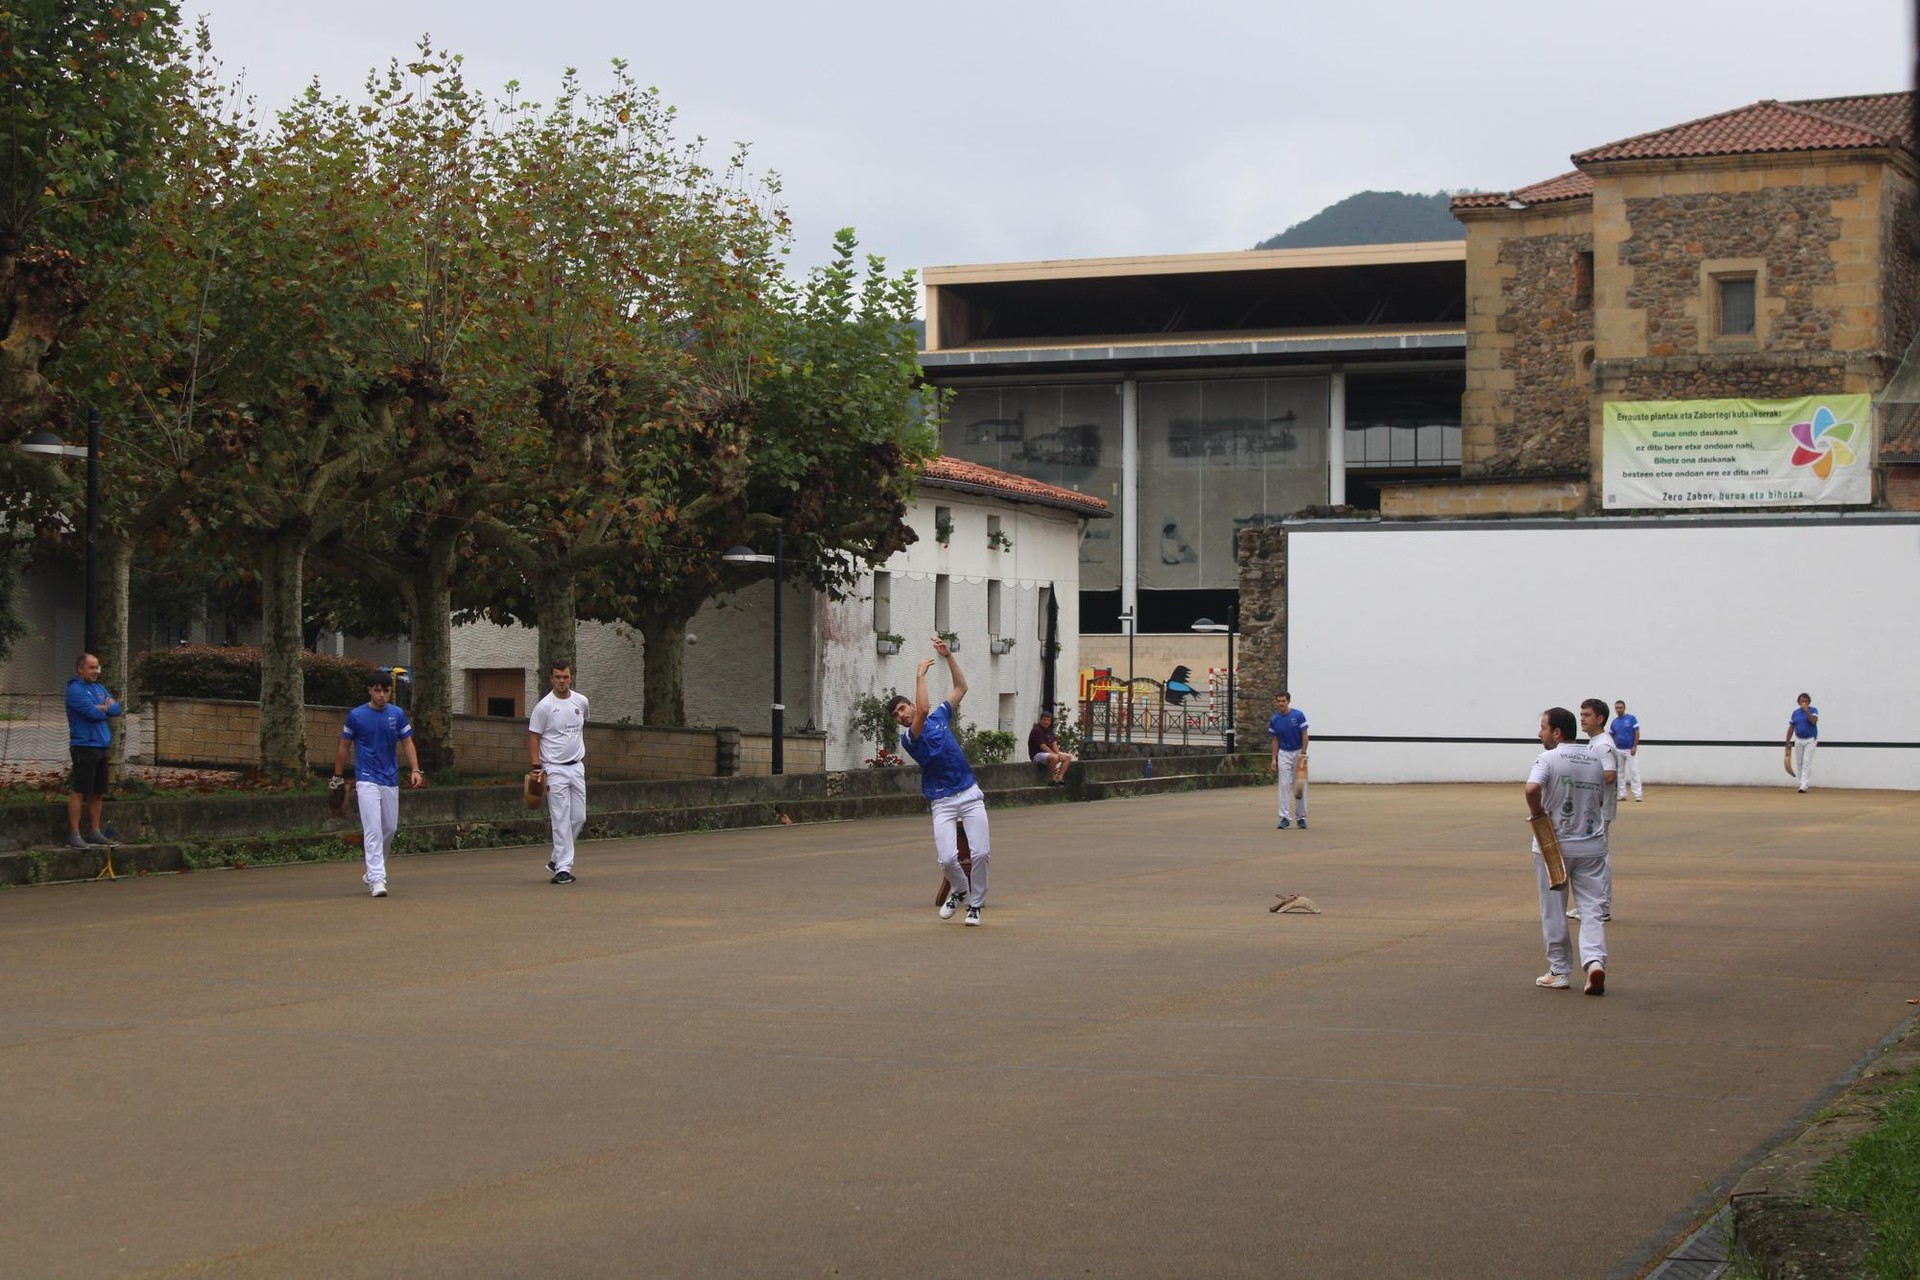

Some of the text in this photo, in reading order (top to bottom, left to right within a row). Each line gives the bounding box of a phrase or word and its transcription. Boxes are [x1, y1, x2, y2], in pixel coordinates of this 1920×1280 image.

[1680, 412, 1692, 420] eta
[1694, 411, 1731, 421] Zabortegi
[1652, 430, 1676, 438] Burua
[1704, 442, 1733, 450] ondoan
[1698, 456, 1736, 464] daukanak
[1751, 468, 1769, 476] nahi
[1662, 492, 1683, 501] Zero
[1687, 492, 1716, 502] Zabor,
[1719, 492, 1746, 500] burua
[1768, 490, 1803, 499] bihotza
